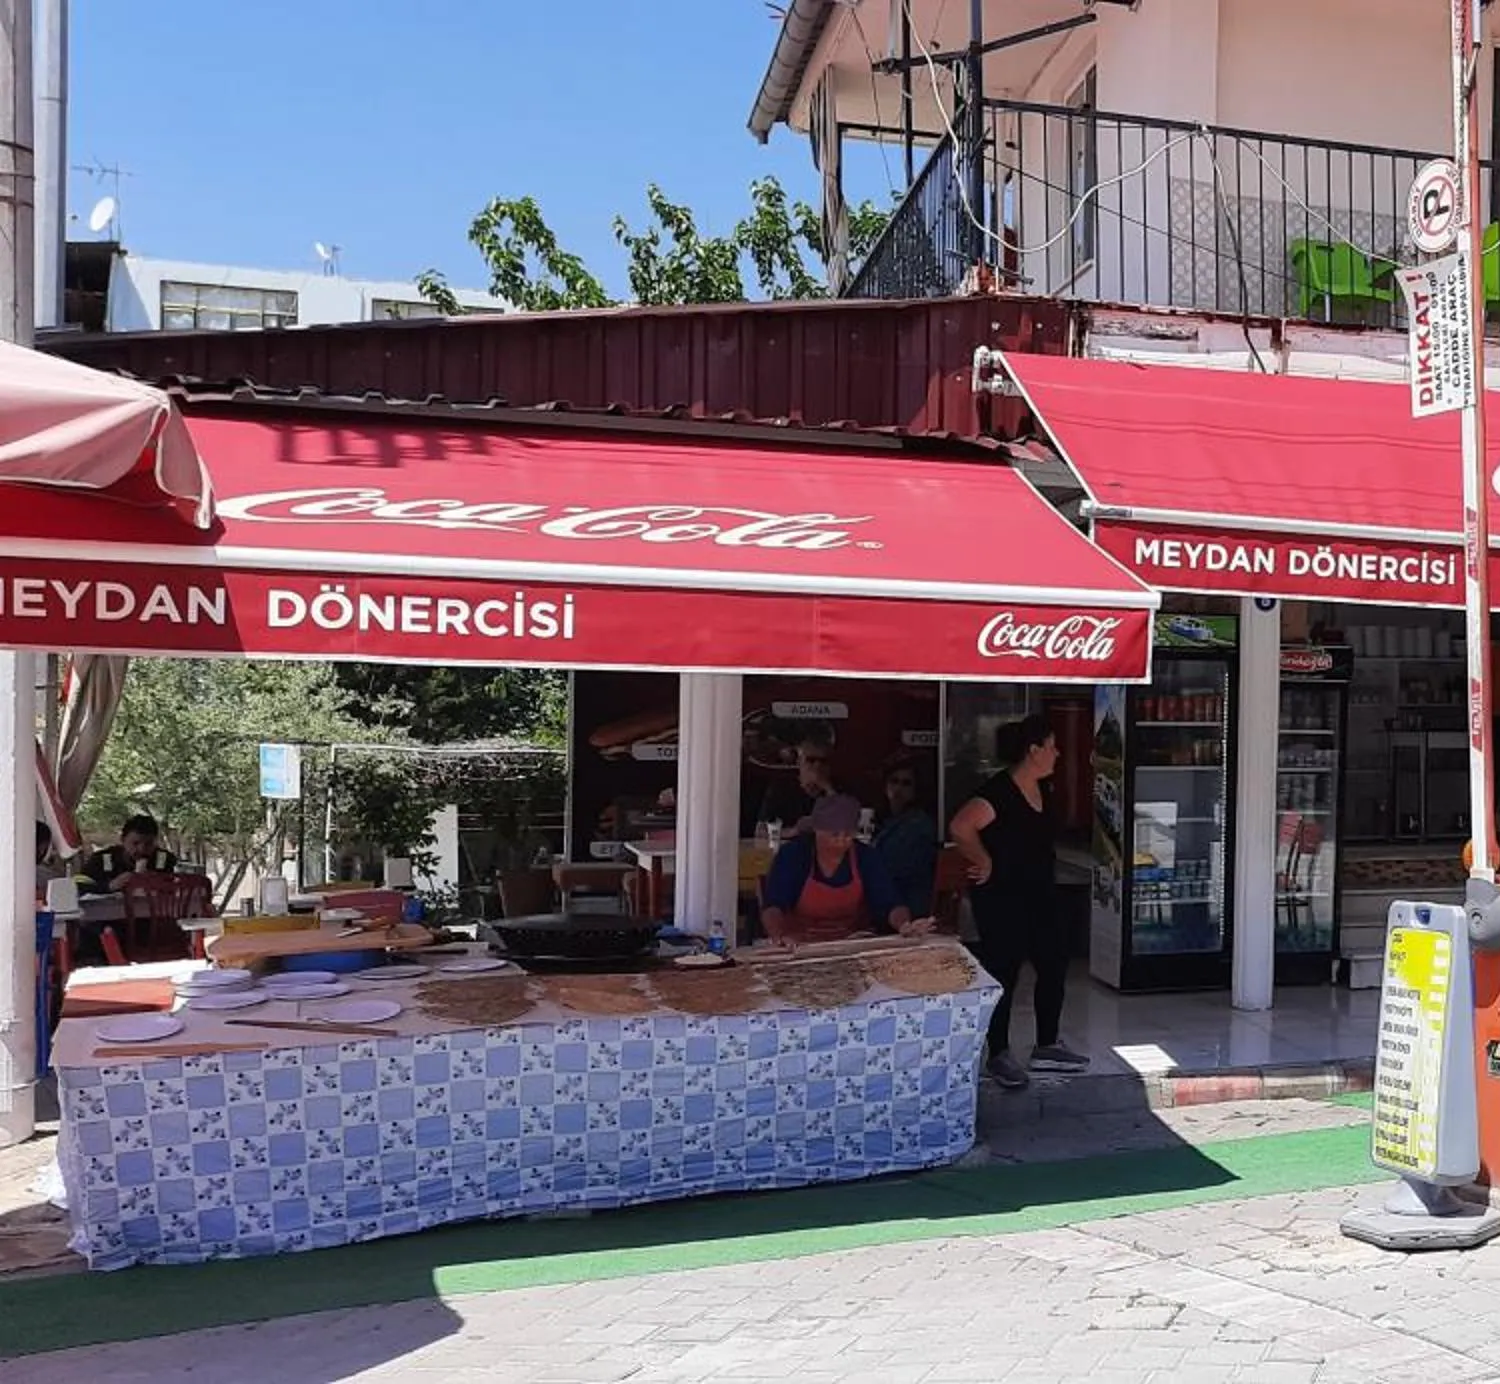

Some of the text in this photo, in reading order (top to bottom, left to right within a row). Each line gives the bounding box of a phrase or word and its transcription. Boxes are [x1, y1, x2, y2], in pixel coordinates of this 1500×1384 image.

[1413, 292, 1433, 406] DİKKAT
[1449, 327, 1460, 388] CADDE
[1433, 364, 1443, 400] SAAT
[214, 487, 875, 550] Coca-Cola
[1135, 538, 1457, 585] MEYDAN DÖNERCİSİ
[0, 577, 576, 639] EYDAN DÖNERCİSİ
[977, 611, 1124, 661] Coca-Cola
